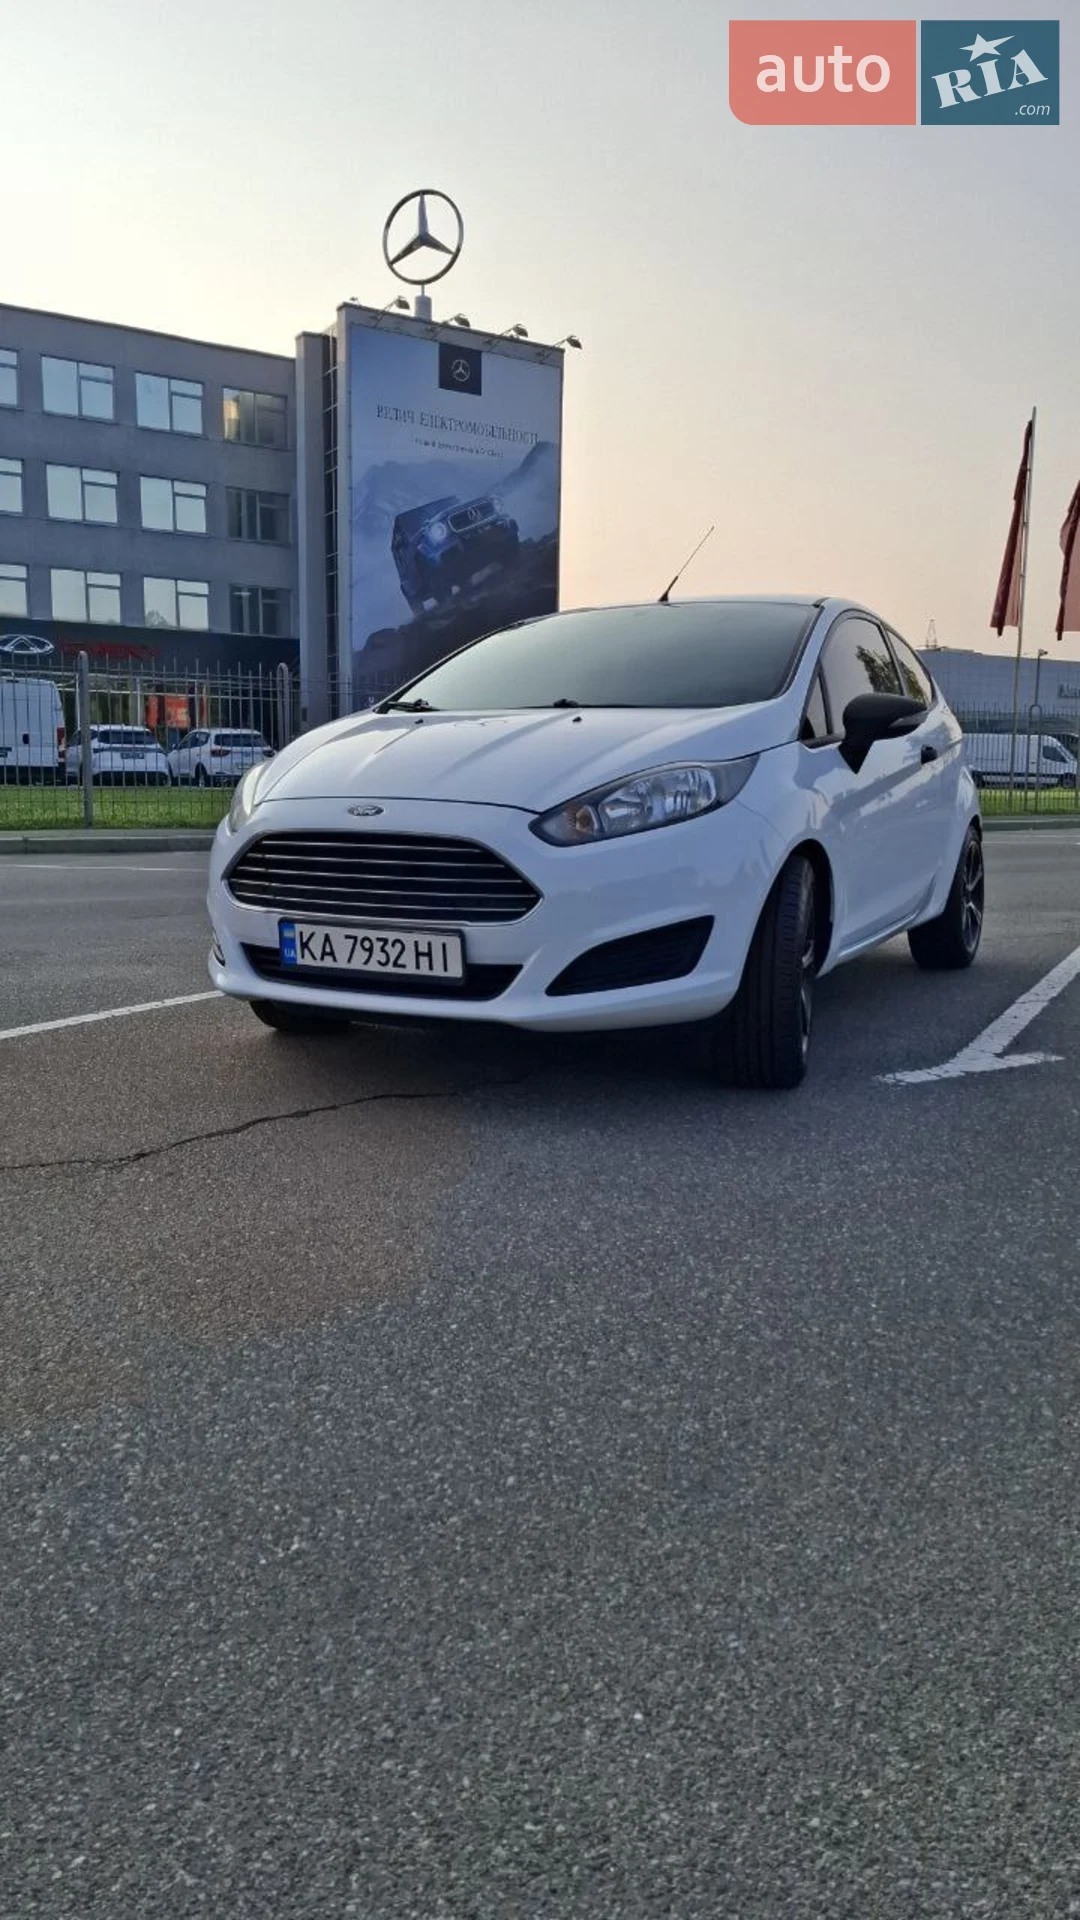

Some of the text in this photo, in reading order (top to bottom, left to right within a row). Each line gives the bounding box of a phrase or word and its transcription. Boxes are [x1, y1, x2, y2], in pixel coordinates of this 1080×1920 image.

[376, 405, 415, 424] ВЕЛИЧ
[300, 931, 448, 972] KA 7932 HI
